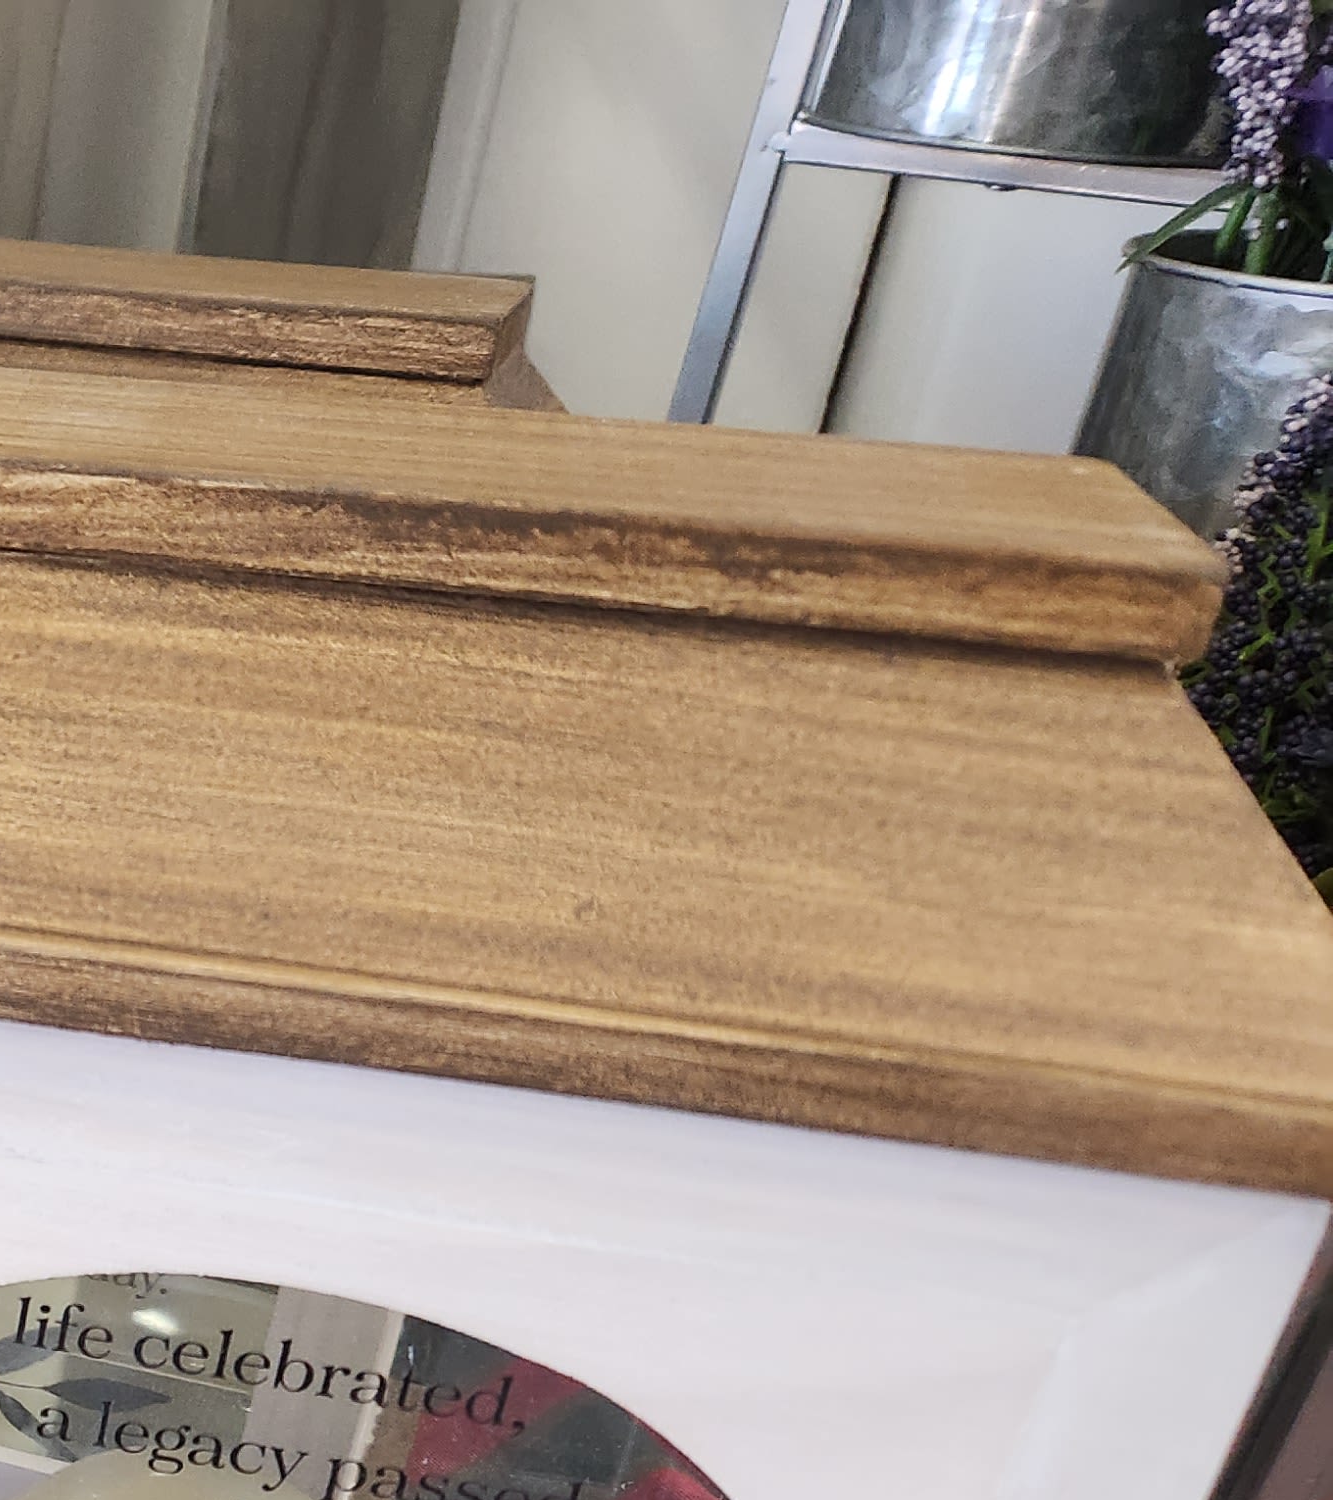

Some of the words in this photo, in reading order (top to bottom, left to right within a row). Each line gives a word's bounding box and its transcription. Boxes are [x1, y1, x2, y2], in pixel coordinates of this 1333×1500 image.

[85, 1273, 167, 1299] ay.
[13, 1296, 113, 1360] life
[134, 1330, 525, 1437] celebrated,
[36, 1407, 73, 1442] a
[92, 1400, 309, 1492] legacy
